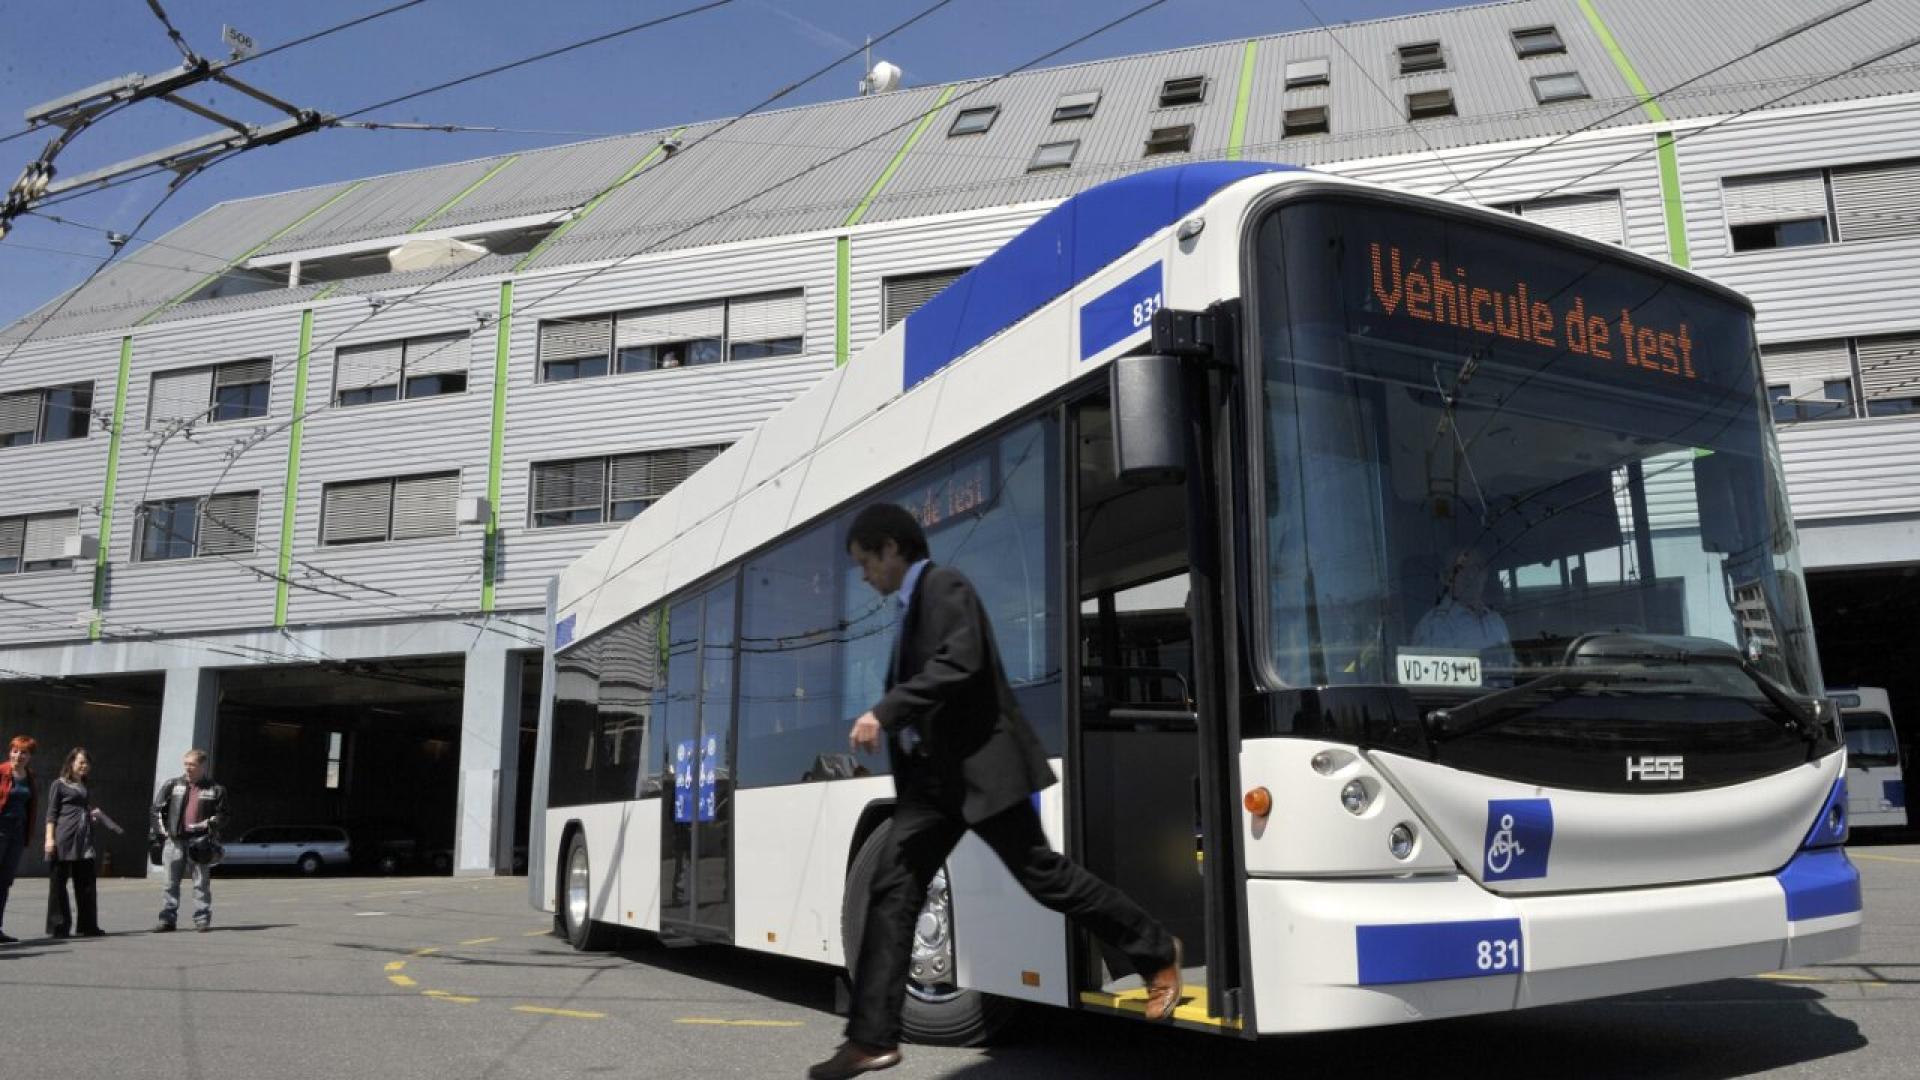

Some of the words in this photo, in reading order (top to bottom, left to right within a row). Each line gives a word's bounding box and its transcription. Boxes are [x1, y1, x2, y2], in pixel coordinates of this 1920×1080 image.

[1132, 292, 1161, 328] 831
[1369, 242, 1556, 347] Véhicule
[1565, 296, 1612, 359] de
[1619, 308, 1696, 379] test
[1626, 755, 1683, 780] HESS
[1476, 938, 1520, 970] 831
